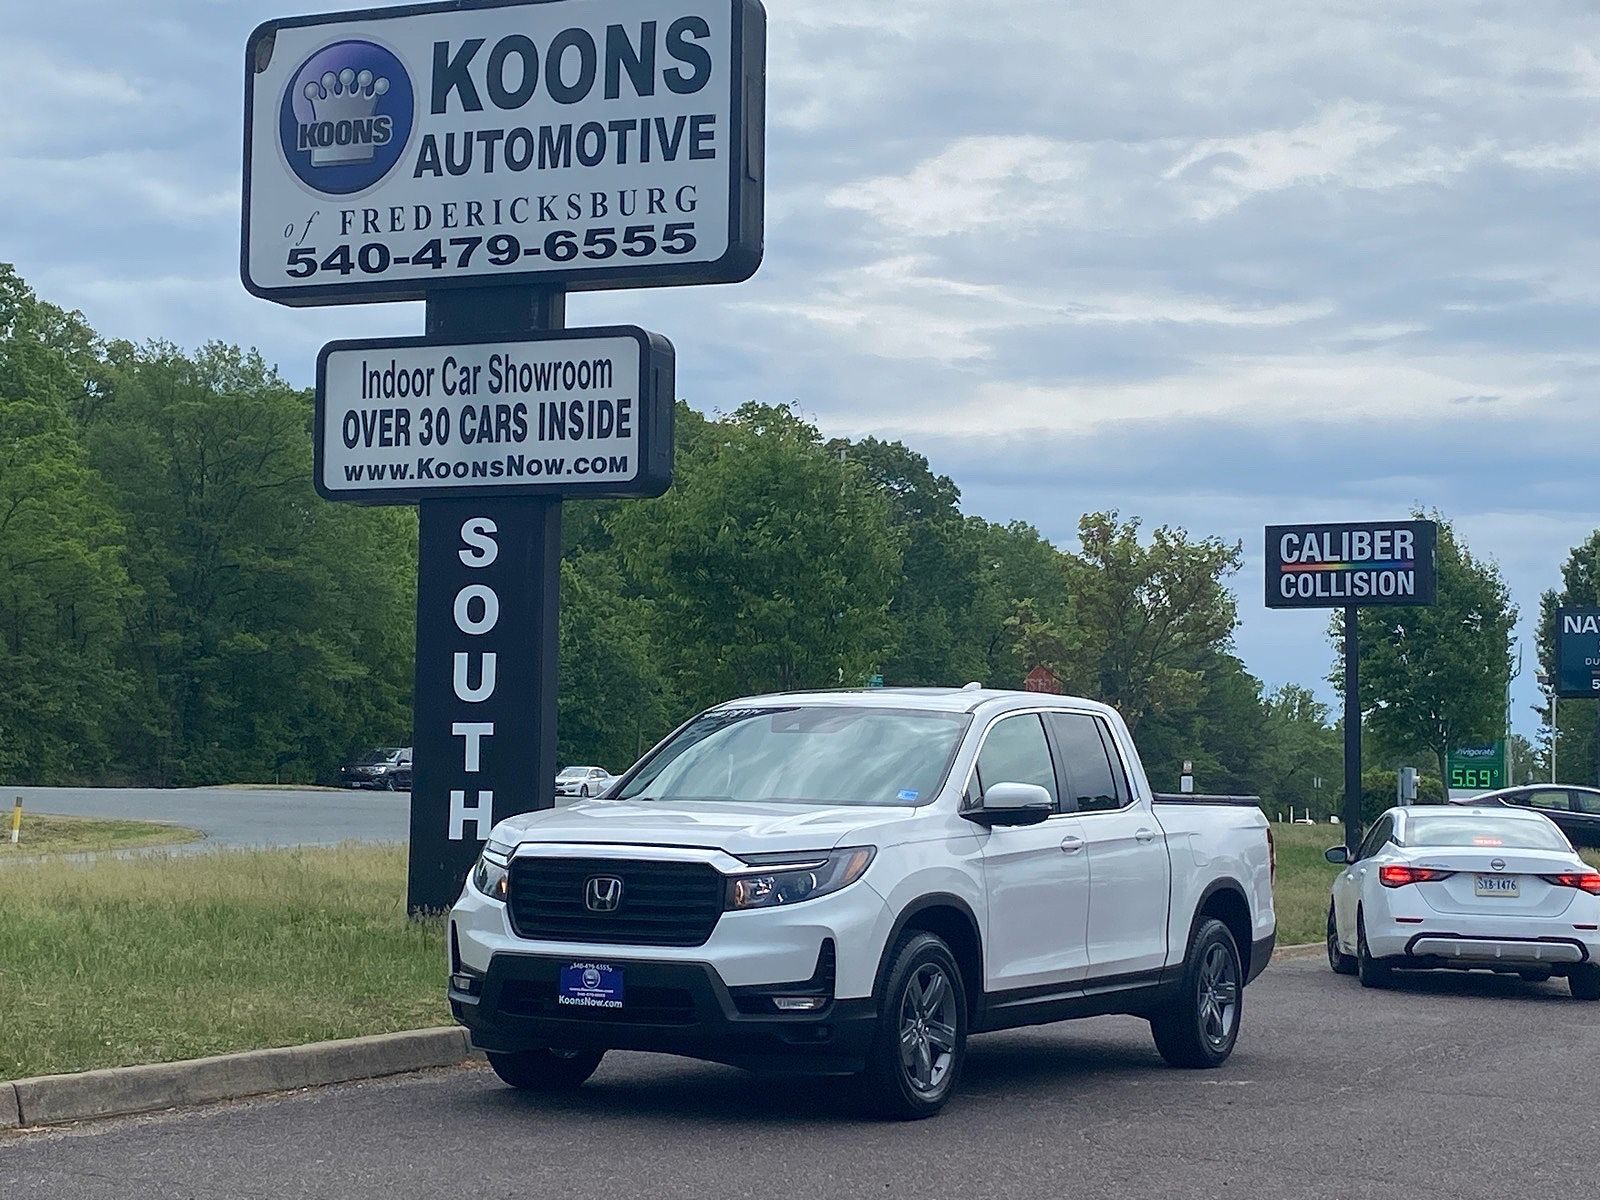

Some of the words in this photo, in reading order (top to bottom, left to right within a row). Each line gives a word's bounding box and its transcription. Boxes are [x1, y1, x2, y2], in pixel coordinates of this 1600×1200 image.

[430, 16, 712, 114] KOONS
[300, 117, 391, 148] KOONS
[413, 114, 717, 178] AUTOMOTIVE
[284, 211, 316, 245] of
[339, 185, 698, 236] FREDERICKSBURG
[286, 222, 697, 278] 540-479-6555
[362, 360, 435, 399] Indoor
[442, 356, 481, 396] Car
[488, 354, 612, 394] Showroom
[343, 408, 411, 450] OVER
[419, 406, 450, 446] 30
[459, 402, 528, 444] CARS
[538, 399, 631, 441] INSIDE
[1280, 529, 1415, 563] CALIBER
[1280, 570, 1415, 598] COLLISION
[1564, 615, 1600, 633] NA
[448, 517, 499, 840] SOUTH
[1452, 769, 1490, 787] 5.69
[558, 994, 623, 1008] KoonsNow.com
